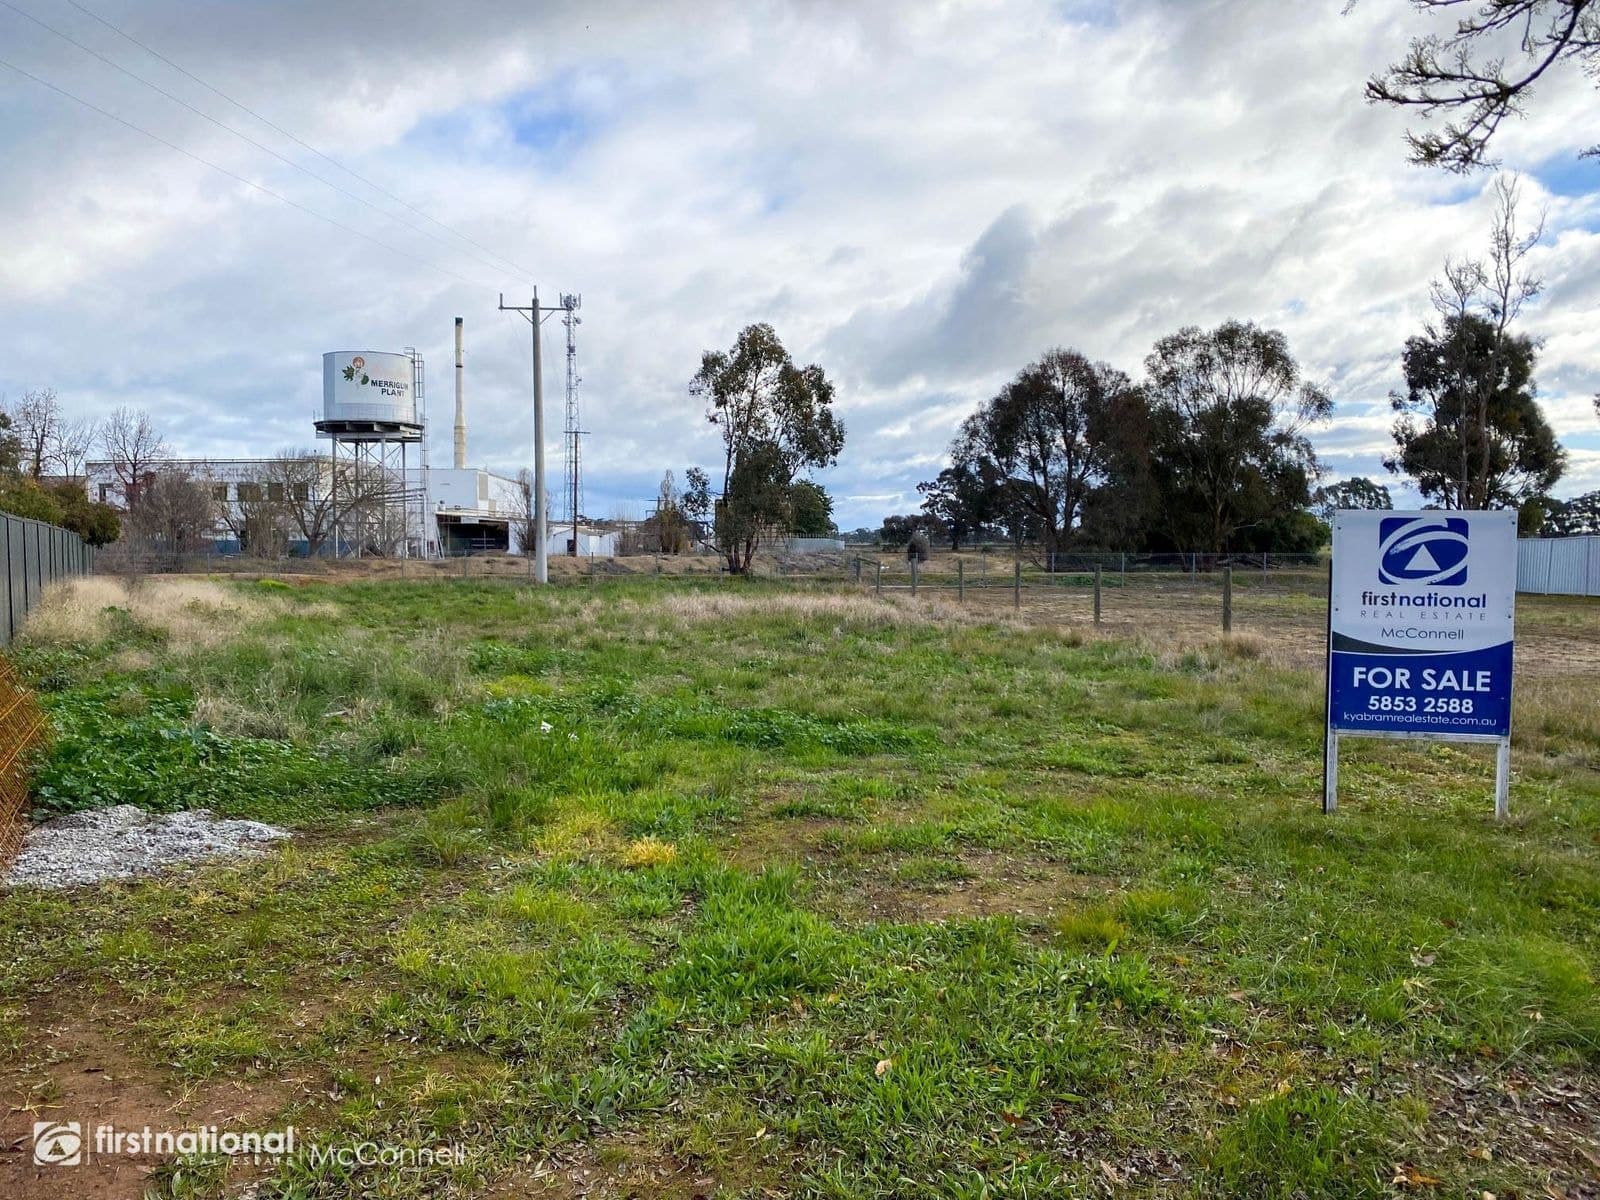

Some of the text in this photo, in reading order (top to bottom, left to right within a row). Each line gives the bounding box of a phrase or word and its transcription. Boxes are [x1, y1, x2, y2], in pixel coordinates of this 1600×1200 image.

[381, 388, 405, 397] PLANT
[1361, 591, 1486, 608] firstnational
[1360, 610, 1486, 621] REAL ESTATE
[1381, 627, 1464, 640] McConnell
[1353, 667, 1491, 692] FOR SALE
[1368, 695, 1474, 714] 5853 2588
[1343, 711, 1497, 726] kyabramrealestate.com.au
